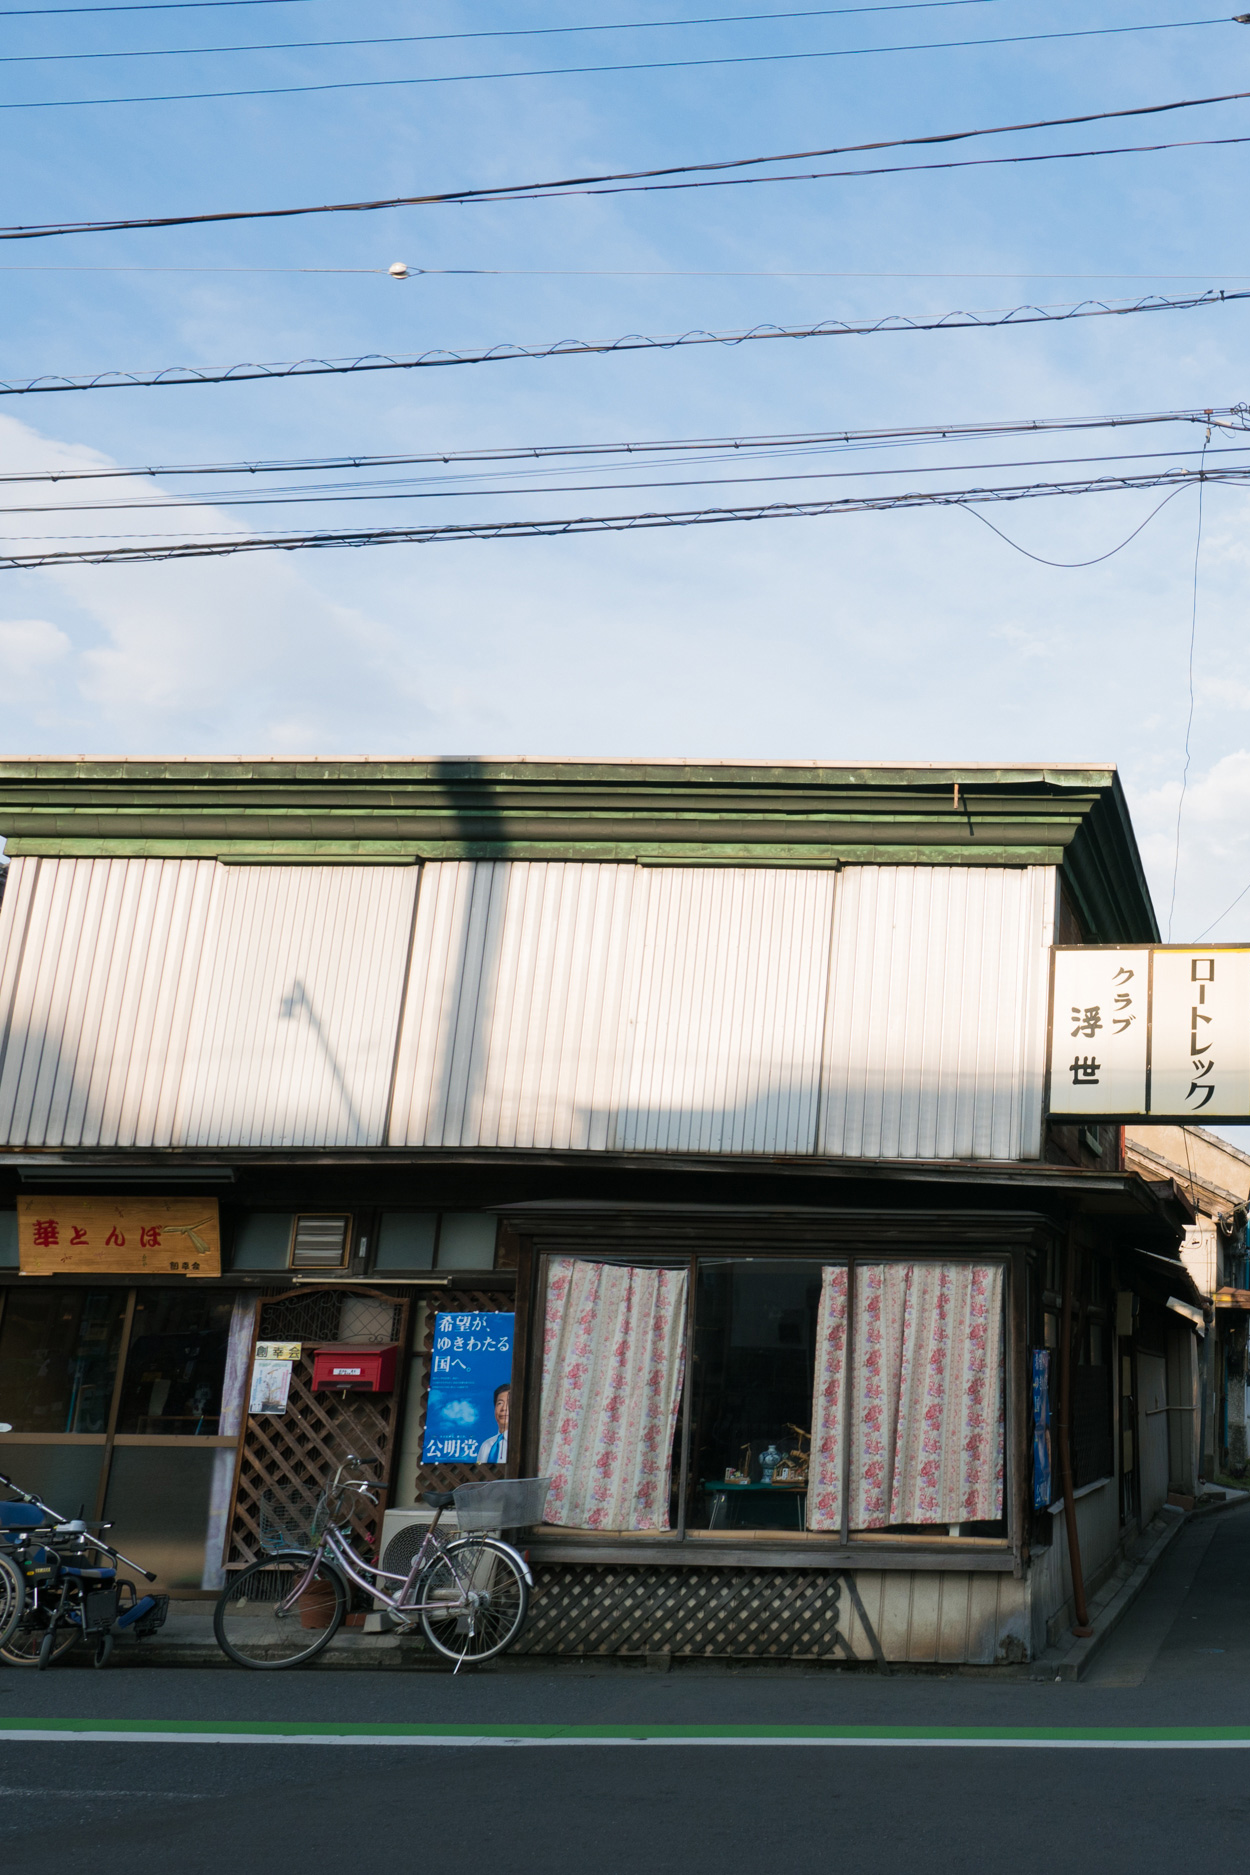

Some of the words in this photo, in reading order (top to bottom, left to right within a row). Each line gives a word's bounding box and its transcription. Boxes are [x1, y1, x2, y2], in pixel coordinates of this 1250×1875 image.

[1112, 967, 1136, 1035] クラブ
[1185, 958, 1215, 1111] ロートレック
[1069, 1005, 1103, 1085] 浮世
[32, 1218, 163, 1248] 華とんぼ
[438, 1315, 490, 1332] 希望が、
[256, 1345, 300, 1358] 創幸会
[437, 1336, 509, 1351] ゆきわたる
[434, 1355, 471, 1373] 国へ。
[426, 1438, 479, 1457] 公明党
